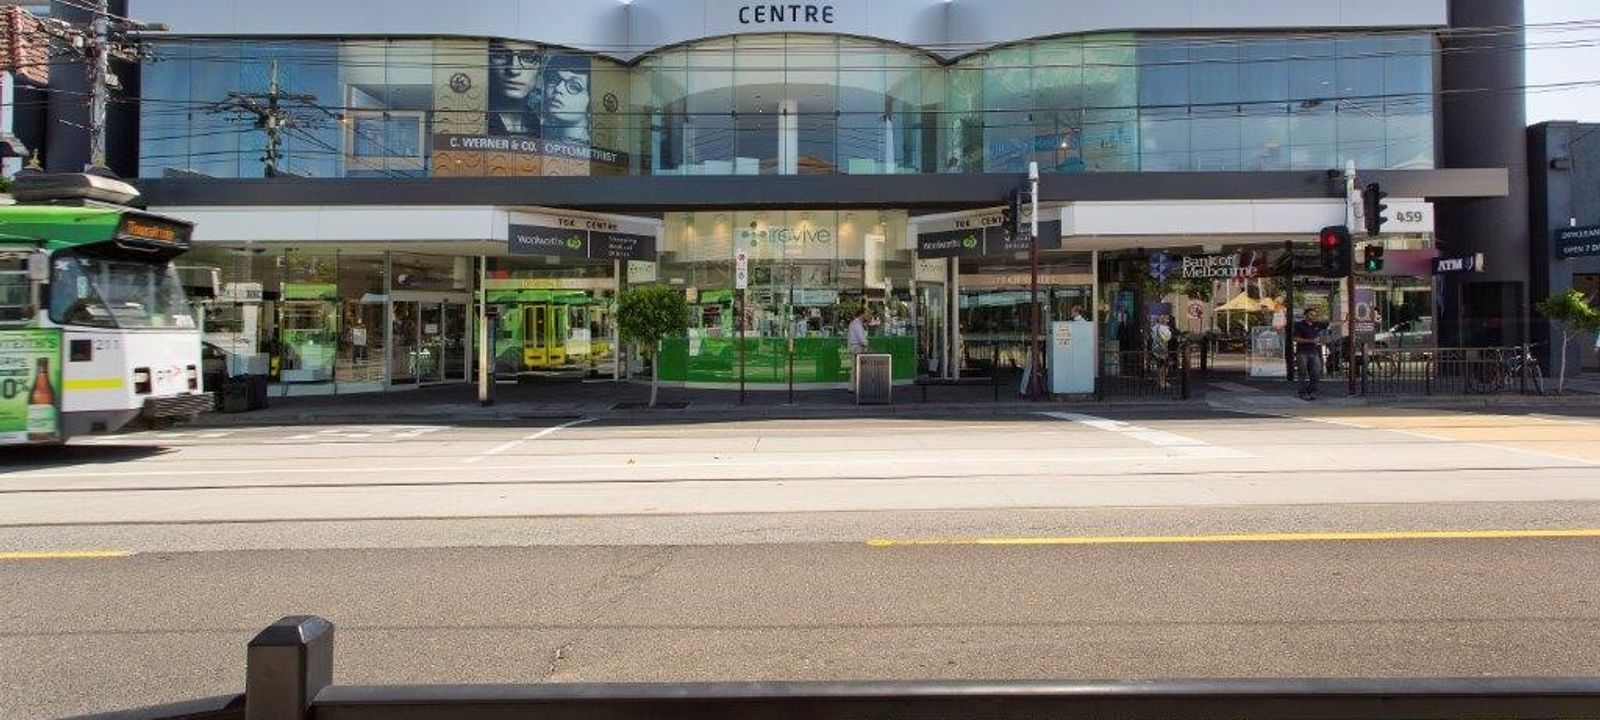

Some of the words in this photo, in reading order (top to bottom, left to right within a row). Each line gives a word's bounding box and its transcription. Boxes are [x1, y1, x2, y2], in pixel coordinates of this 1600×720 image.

[738, 5, 834, 24] CENTRE
[450, 138, 459, 148] C.
[463, 138, 509, 151] WERNER
[512, 141, 518, 150] &
[545, 142, 617, 162] OPTOMETRIST
[1396, 211, 1422, 222] 459
[586, 220, 618, 231] CENTRE
[517, 234, 564, 246] Woolworths
[1564, 246, 1584, 254] OPEN
[1182, 256, 1217, 266] Bank
[1220, 256, 1233, 266] of
[1438, 259, 1462, 271] ATM
[1182, 265, 1257, 278] Melbourne
